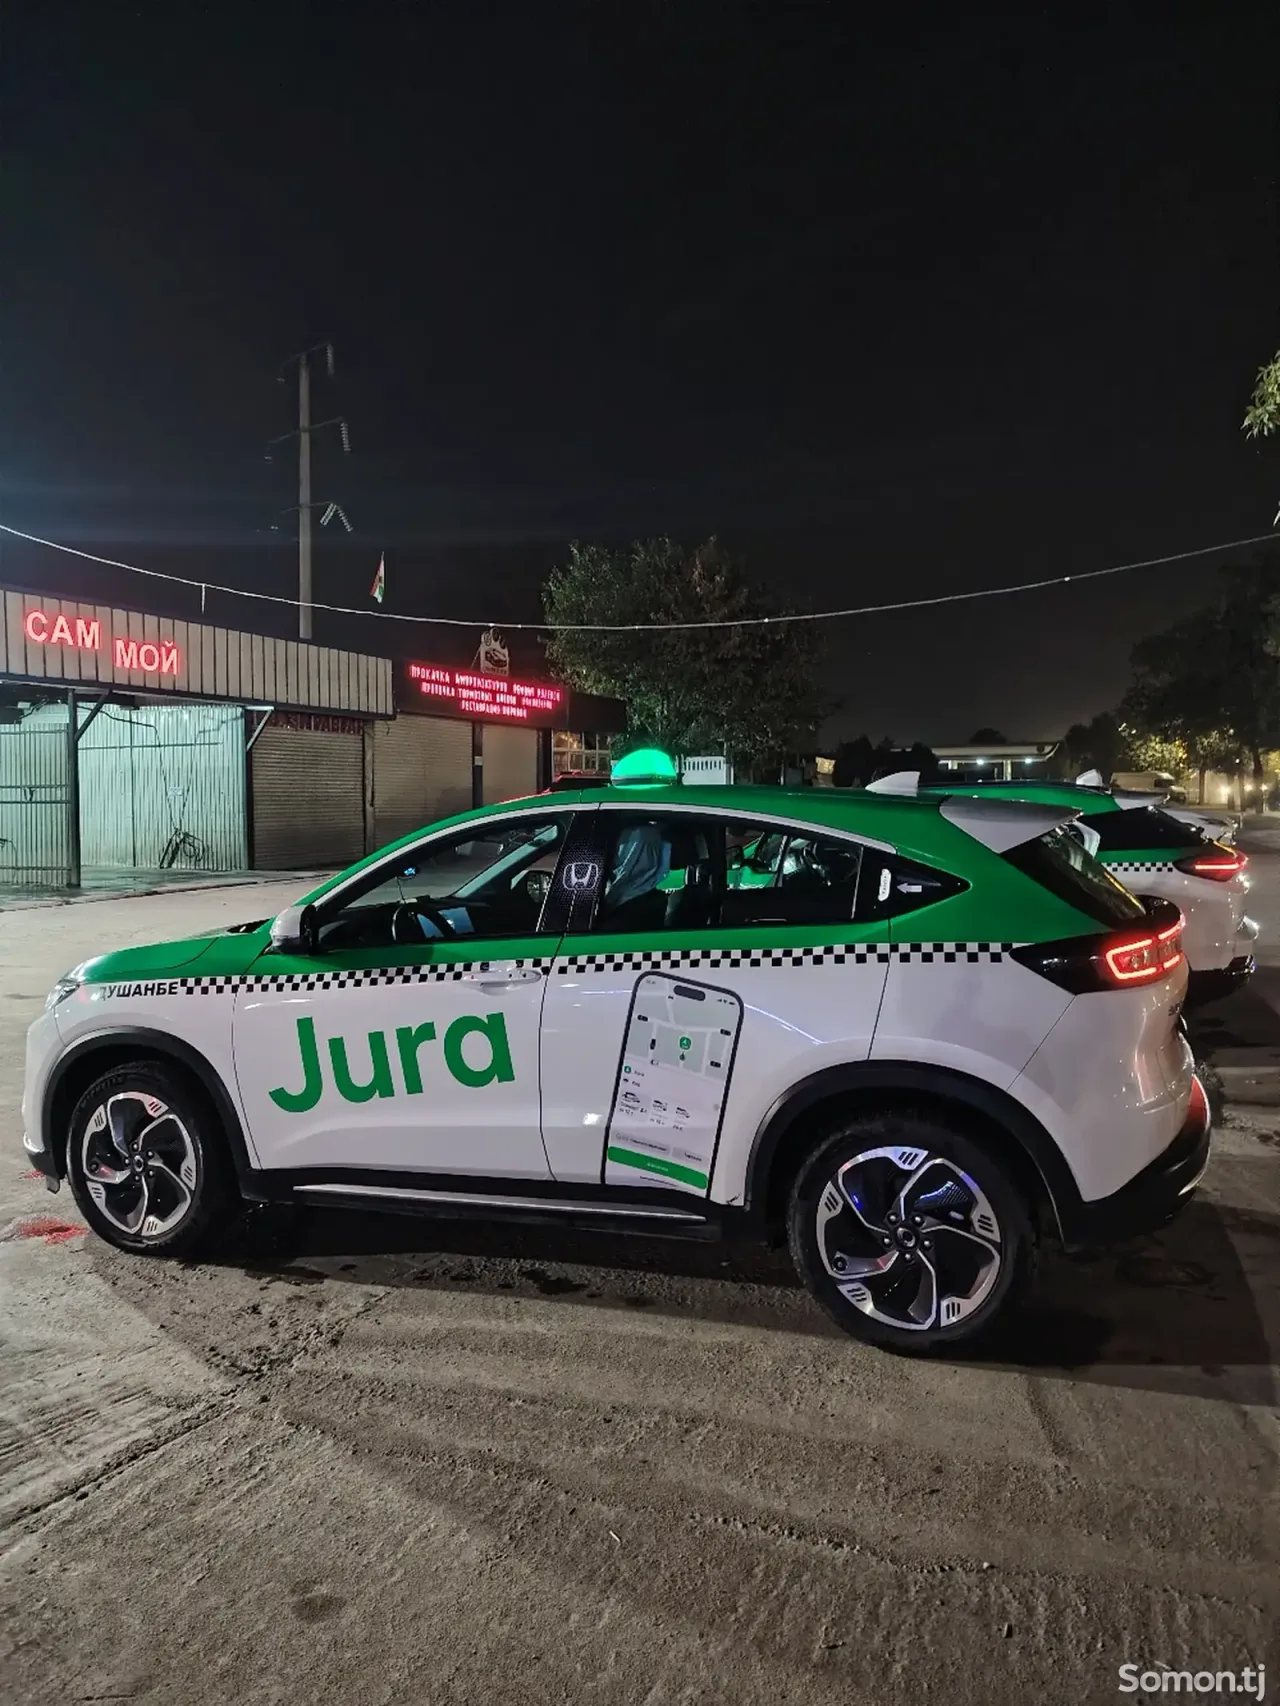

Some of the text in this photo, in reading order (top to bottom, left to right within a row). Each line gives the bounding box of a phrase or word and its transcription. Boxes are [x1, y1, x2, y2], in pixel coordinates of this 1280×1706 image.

[25, 610, 180, 675] САМ МОЙ
[268, 1012, 515, 1112] Jura
